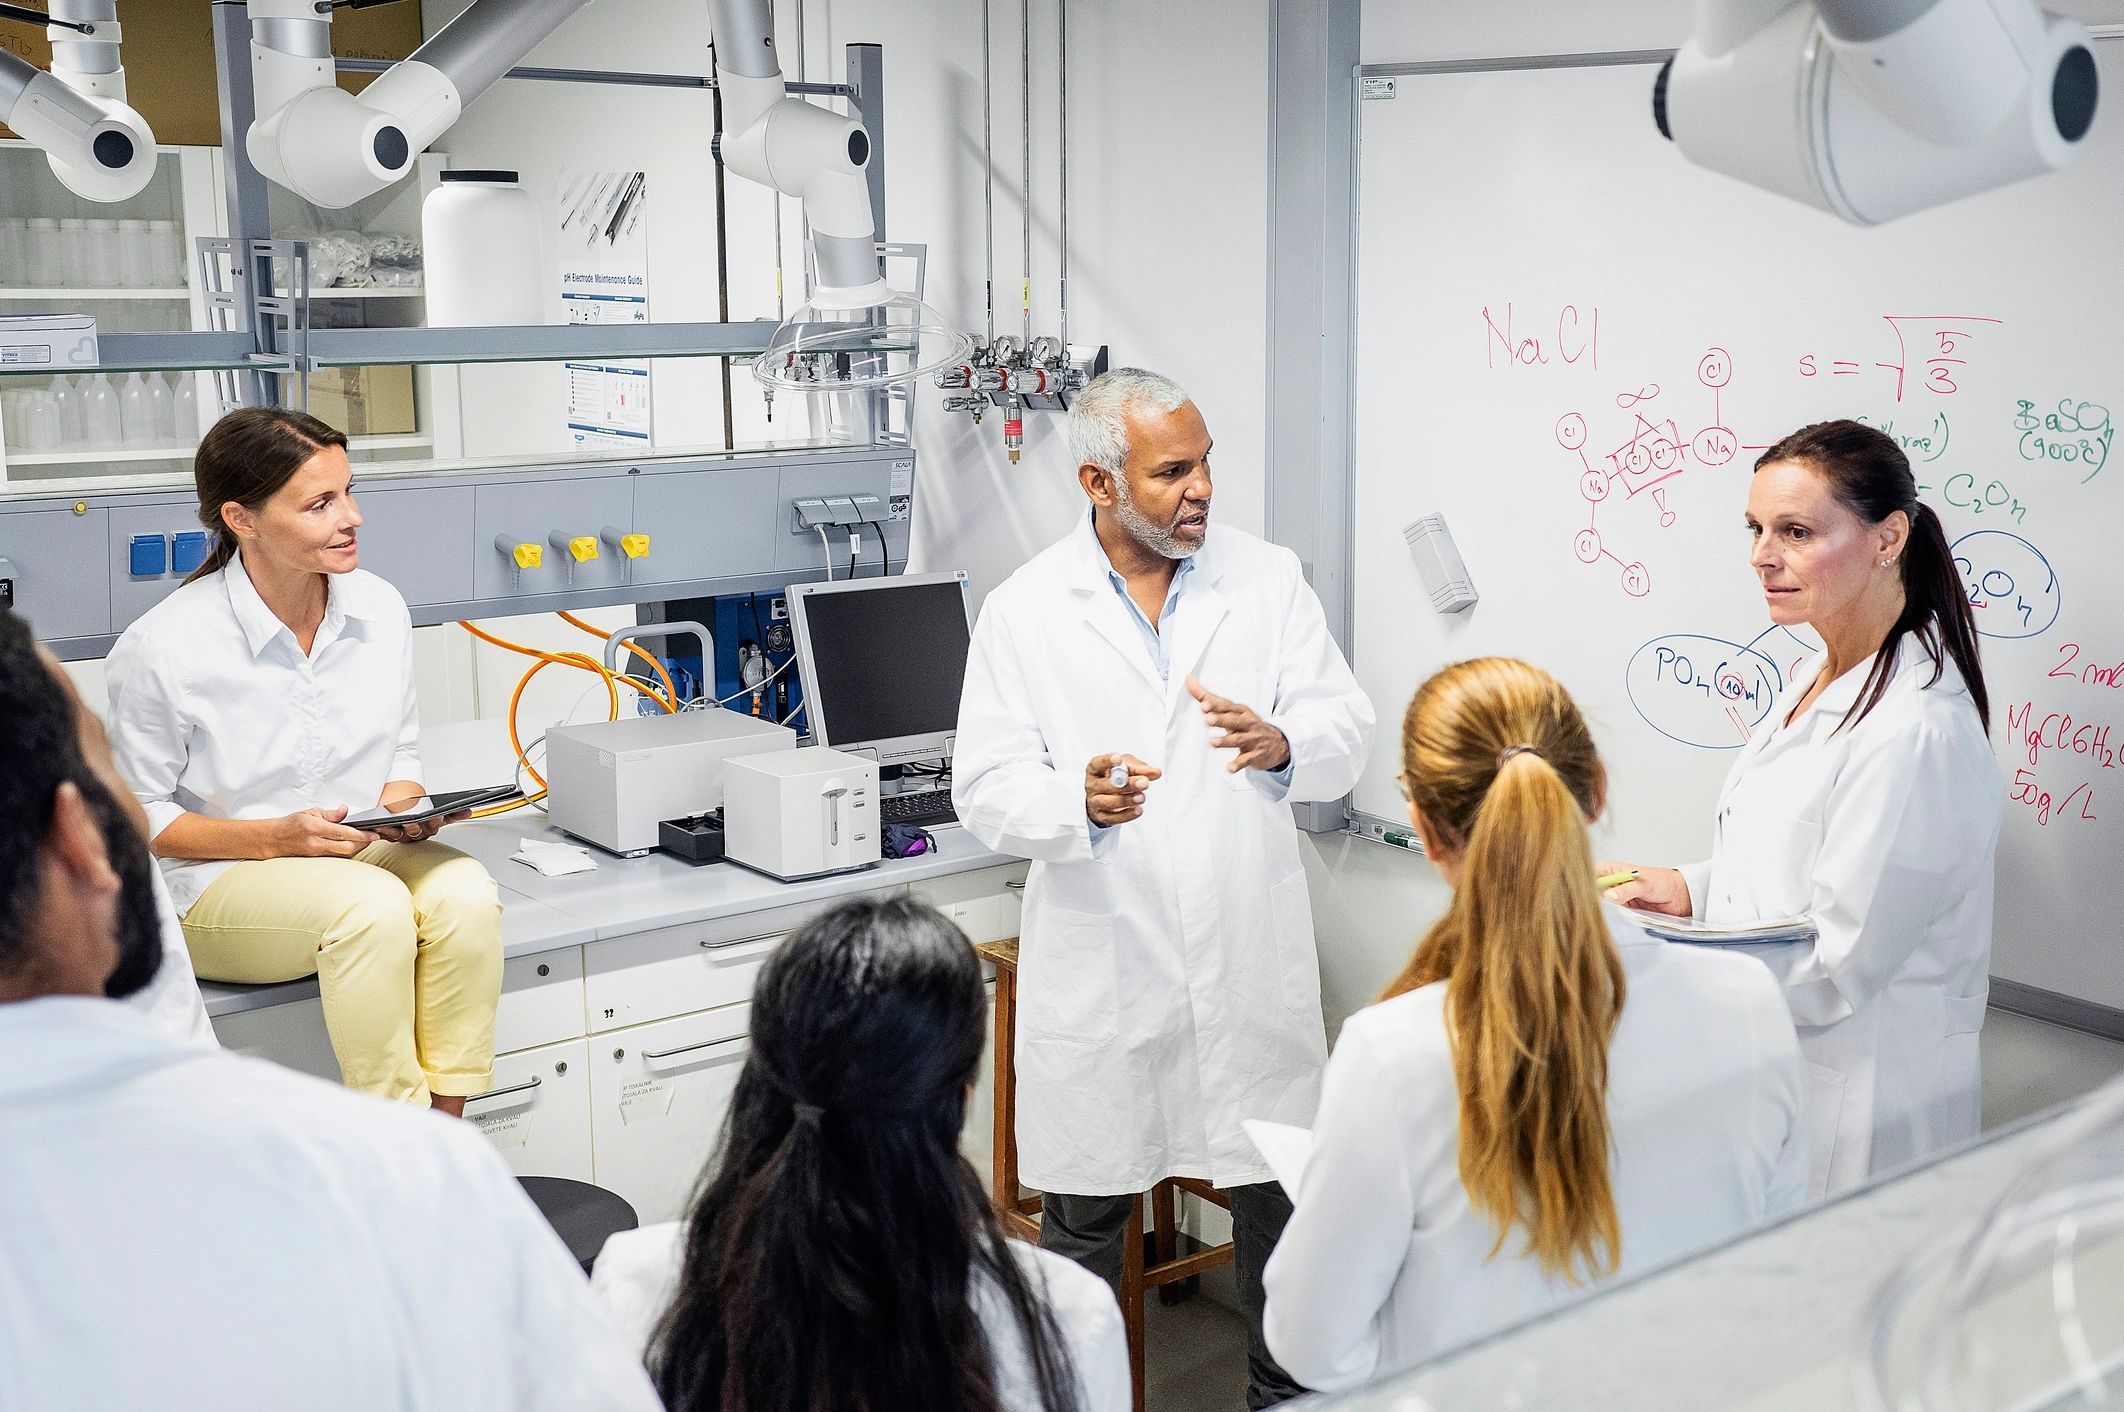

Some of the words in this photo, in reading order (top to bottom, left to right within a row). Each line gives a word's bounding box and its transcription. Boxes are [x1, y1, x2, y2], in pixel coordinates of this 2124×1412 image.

[563, 273, 571, 283] pH
[572, 272, 594, 283] Electrode
[594, 273, 626, 285] Maintenance
[627, 275, 643, 285] Guide
[1935, 331, 1973, 354] 5
[1924, 367, 1957, 394] 3
[1706, 435, 1732, 457] Na
[2048, 643, 2077, 678] 2
[604, 1008, 614, 1019] 32
